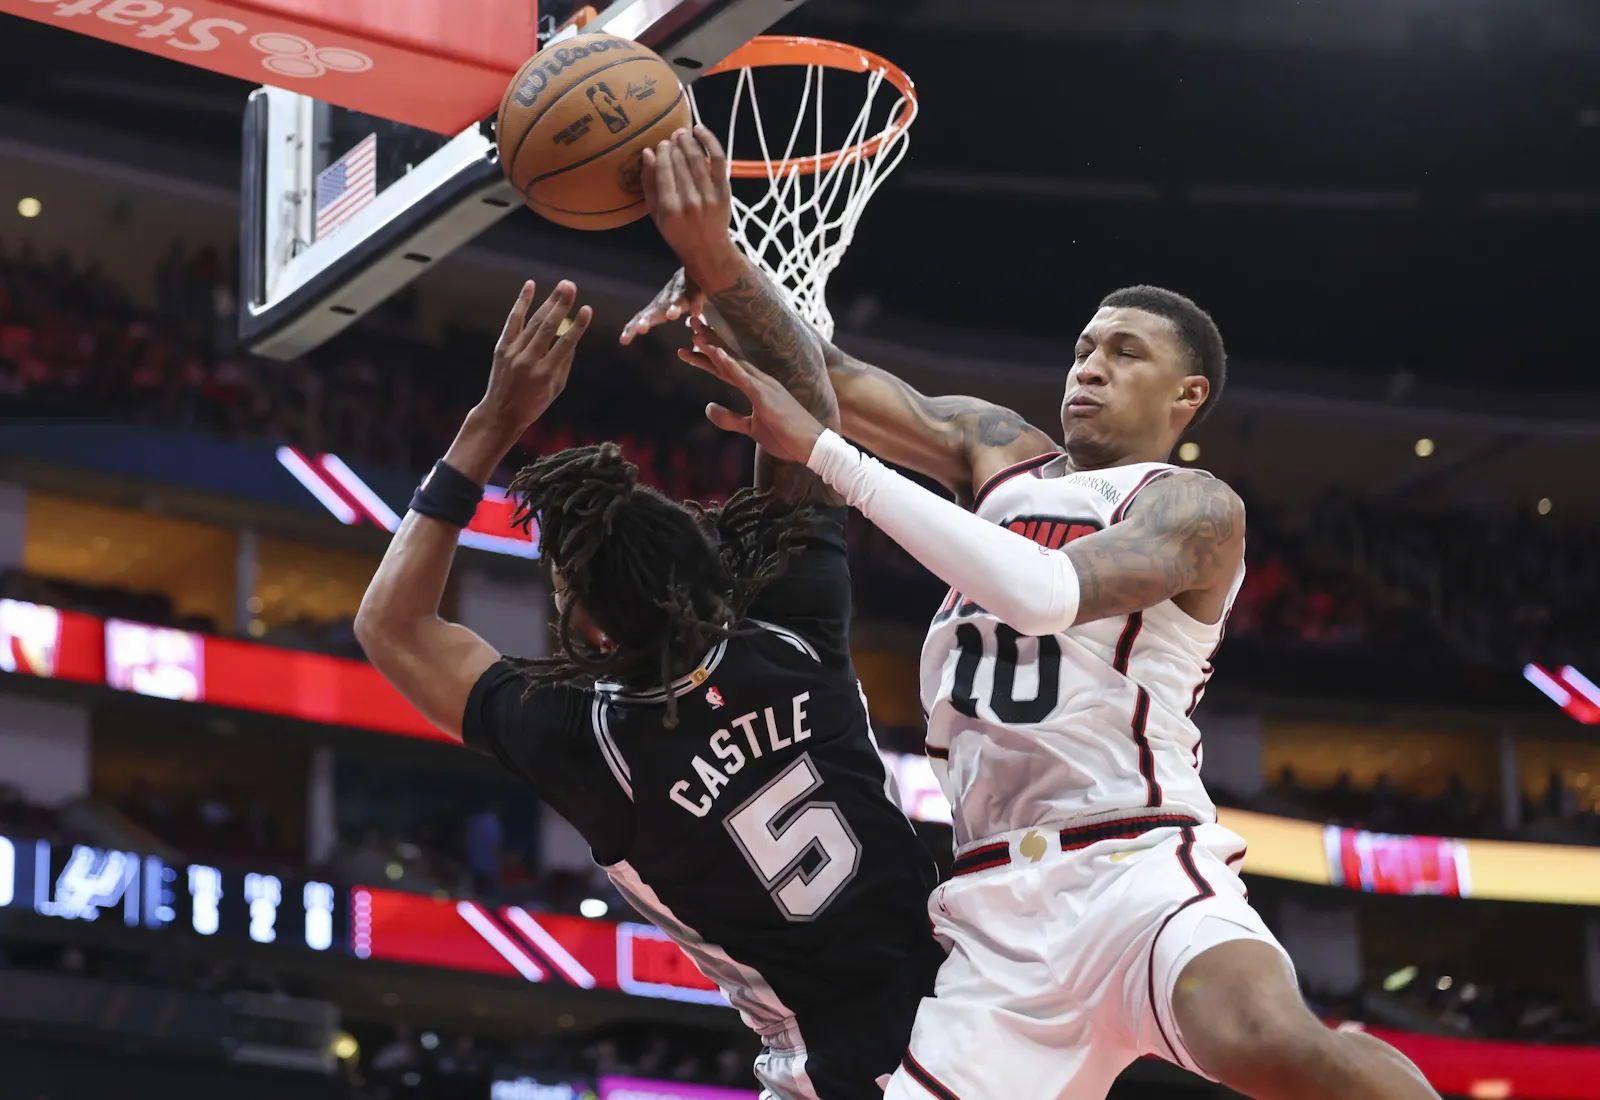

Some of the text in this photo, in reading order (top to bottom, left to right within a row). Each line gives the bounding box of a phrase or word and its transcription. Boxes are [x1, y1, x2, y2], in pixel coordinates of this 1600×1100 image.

[27, 0, 247, 51] Stat
[515, 39, 636, 107] Wilson
[949, 622, 1063, 724] 10
[669, 691, 811, 817] CASTLE
[722, 751, 862, 922] 5
